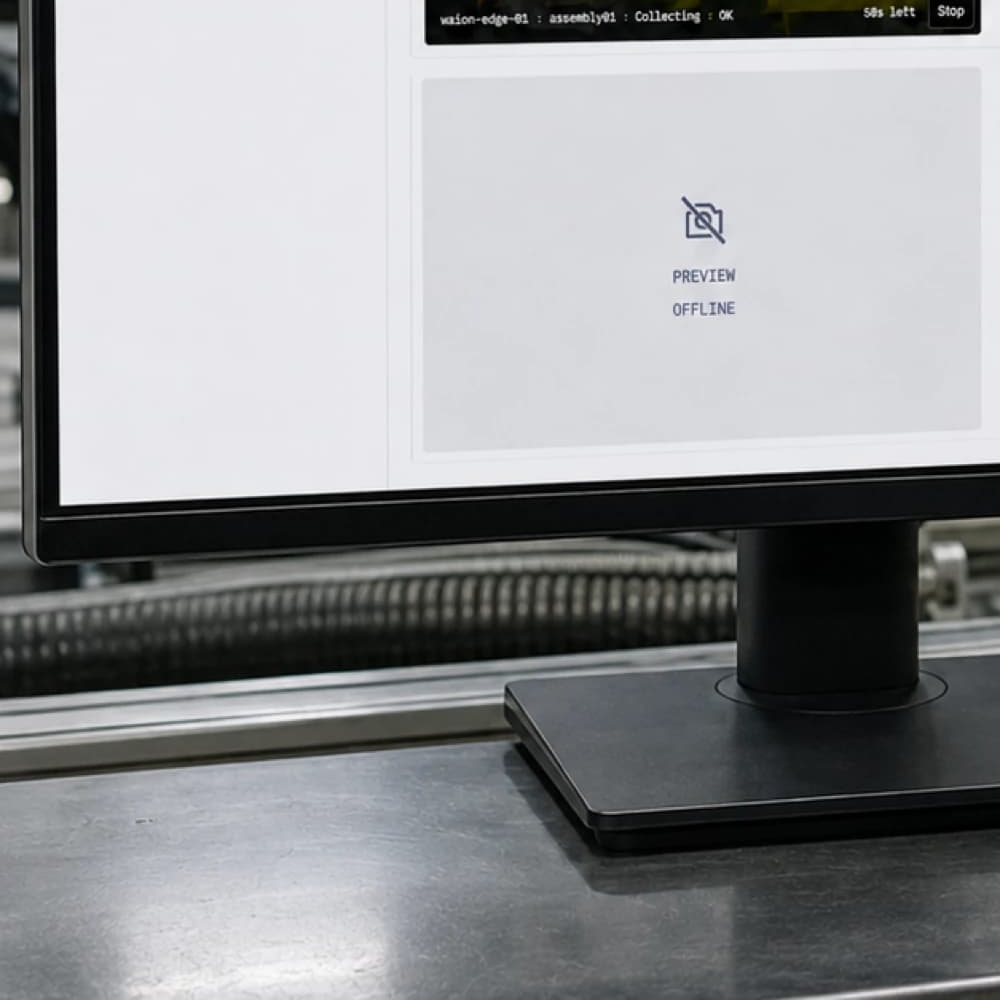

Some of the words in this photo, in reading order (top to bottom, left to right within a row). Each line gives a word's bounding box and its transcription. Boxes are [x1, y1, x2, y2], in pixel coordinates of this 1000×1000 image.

[440, 13, 528, 27] waion-edge-01
[549, 11, 616, 25] assembly01
[635, 9, 701, 24] Collecting
[719, 9, 734, 21] OK
[890, 6, 916, 18] left
[938, 5, 965, 19] Stop
[673, 268, 736, 284] PREVIEW
[673, 301, 735, 316] OFFLINE
